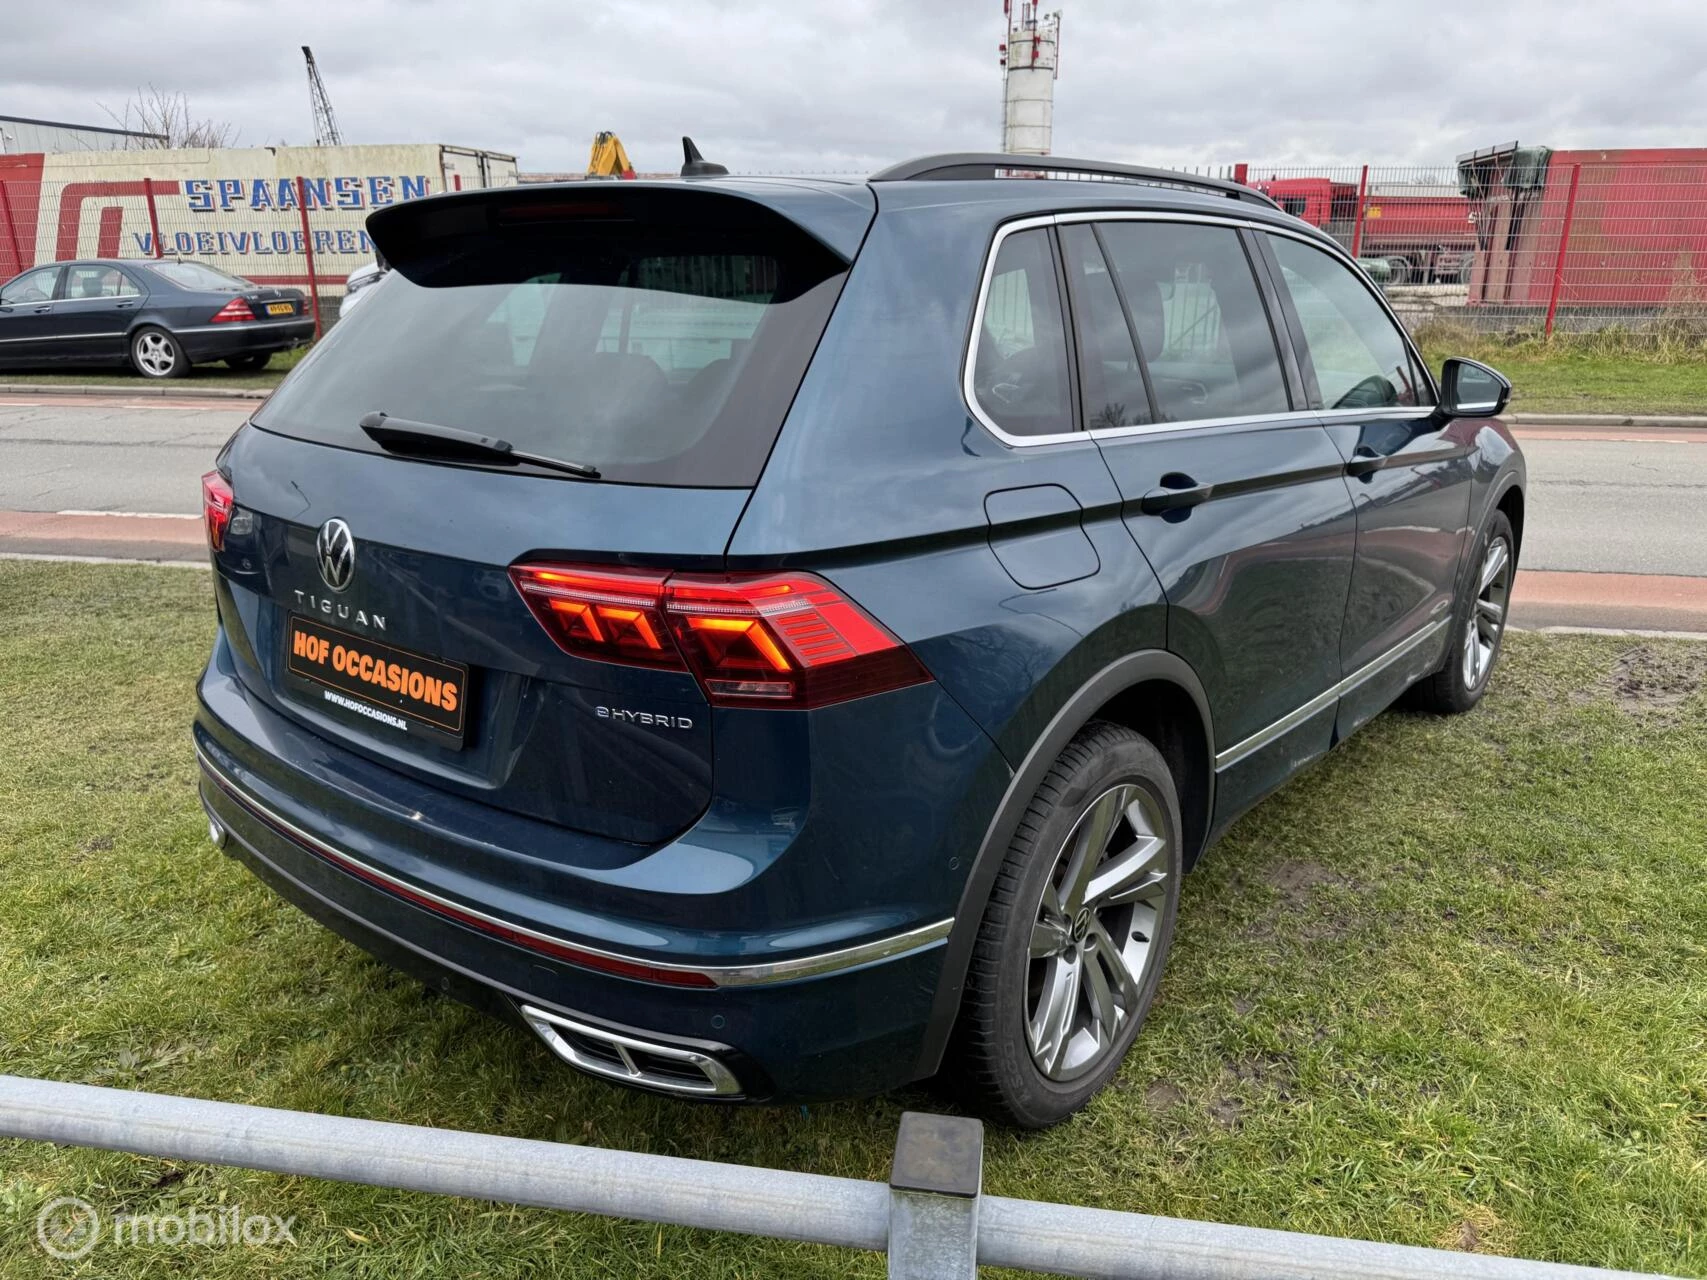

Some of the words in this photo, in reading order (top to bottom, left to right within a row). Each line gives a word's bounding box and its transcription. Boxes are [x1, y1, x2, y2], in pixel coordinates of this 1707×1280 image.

[185, 175, 430, 212] SPAANSEN
[294, 589, 387, 631] TIGUAN
[293, 630, 330, 665] HOF
[332, 645, 458, 712] OCCASIONS
[324, 690, 408, 733] WWW.HOFOCCASIONS.NL
